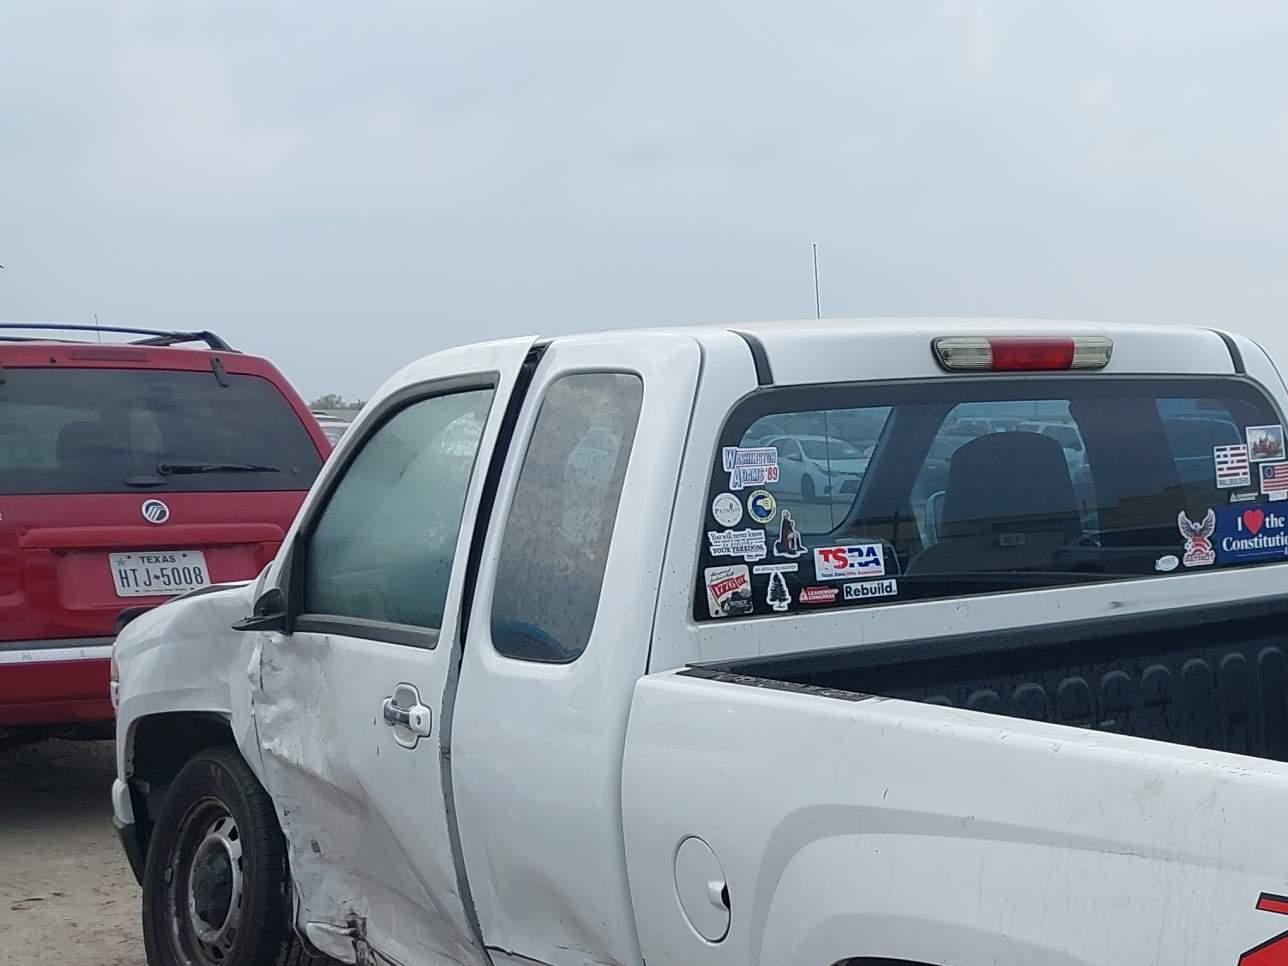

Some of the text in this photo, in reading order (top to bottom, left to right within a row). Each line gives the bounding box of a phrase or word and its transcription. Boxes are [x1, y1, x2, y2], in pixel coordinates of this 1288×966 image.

[725, 449, 776, 470] WASHINGTON
[732, 466, 778, 488] ADAMS '89
[1237, 513, 1285, 531] I the
[139, 555, 176, 564] TEXAS
[714, 580, 736, 596] 1776
[845, 582, 896, 598] Rebuild.
